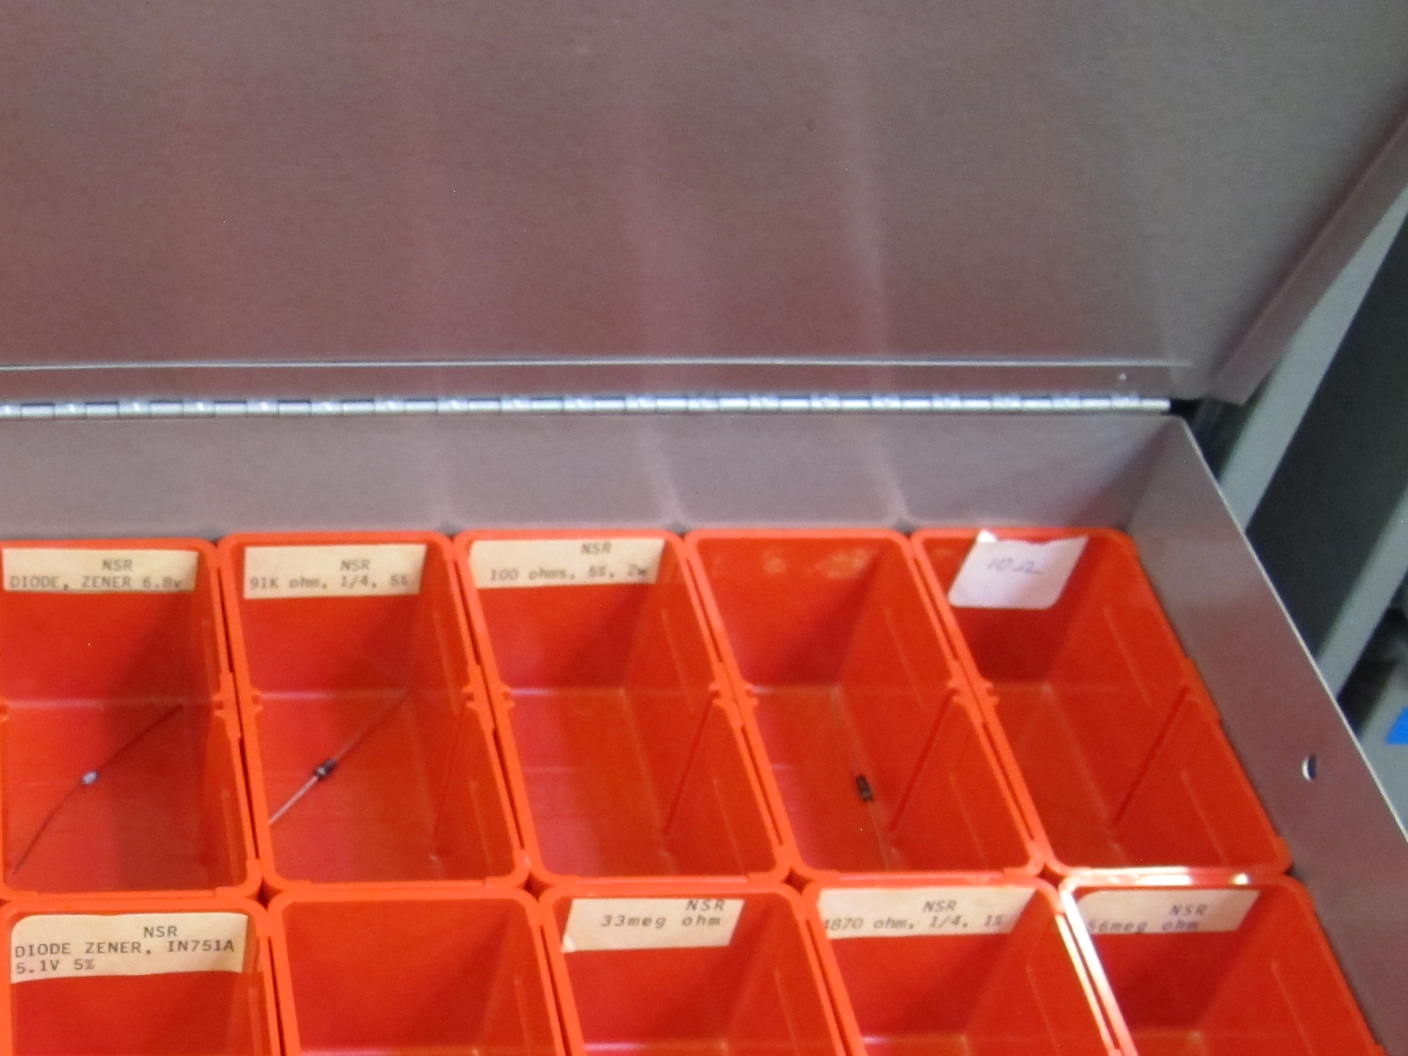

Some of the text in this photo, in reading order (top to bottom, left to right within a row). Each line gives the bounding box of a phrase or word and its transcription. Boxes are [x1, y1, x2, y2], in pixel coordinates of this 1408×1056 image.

[581, 541, 612, 555] NSR
[101, 558, 134, 572] NSR
[340, 559, 371, 572] NSR
[81, 575, 132, 589] ZENER
[489, 568, 520, 582] 100
[249, 576, 280, 590] 91K
[685, 898, 726, 912] NSR
[922, 899, 957, 912] NSR
[1168, 904, 1208, 917] NSR
[601, 914, 721, 930] 33meg ohm
[1161, 919, 1201, 931] ohm
[143, 925, 179, 938] NSR
[15, 942, 72, 958] DIODE
[16, 958, 96, 974] 5.1V 5%
